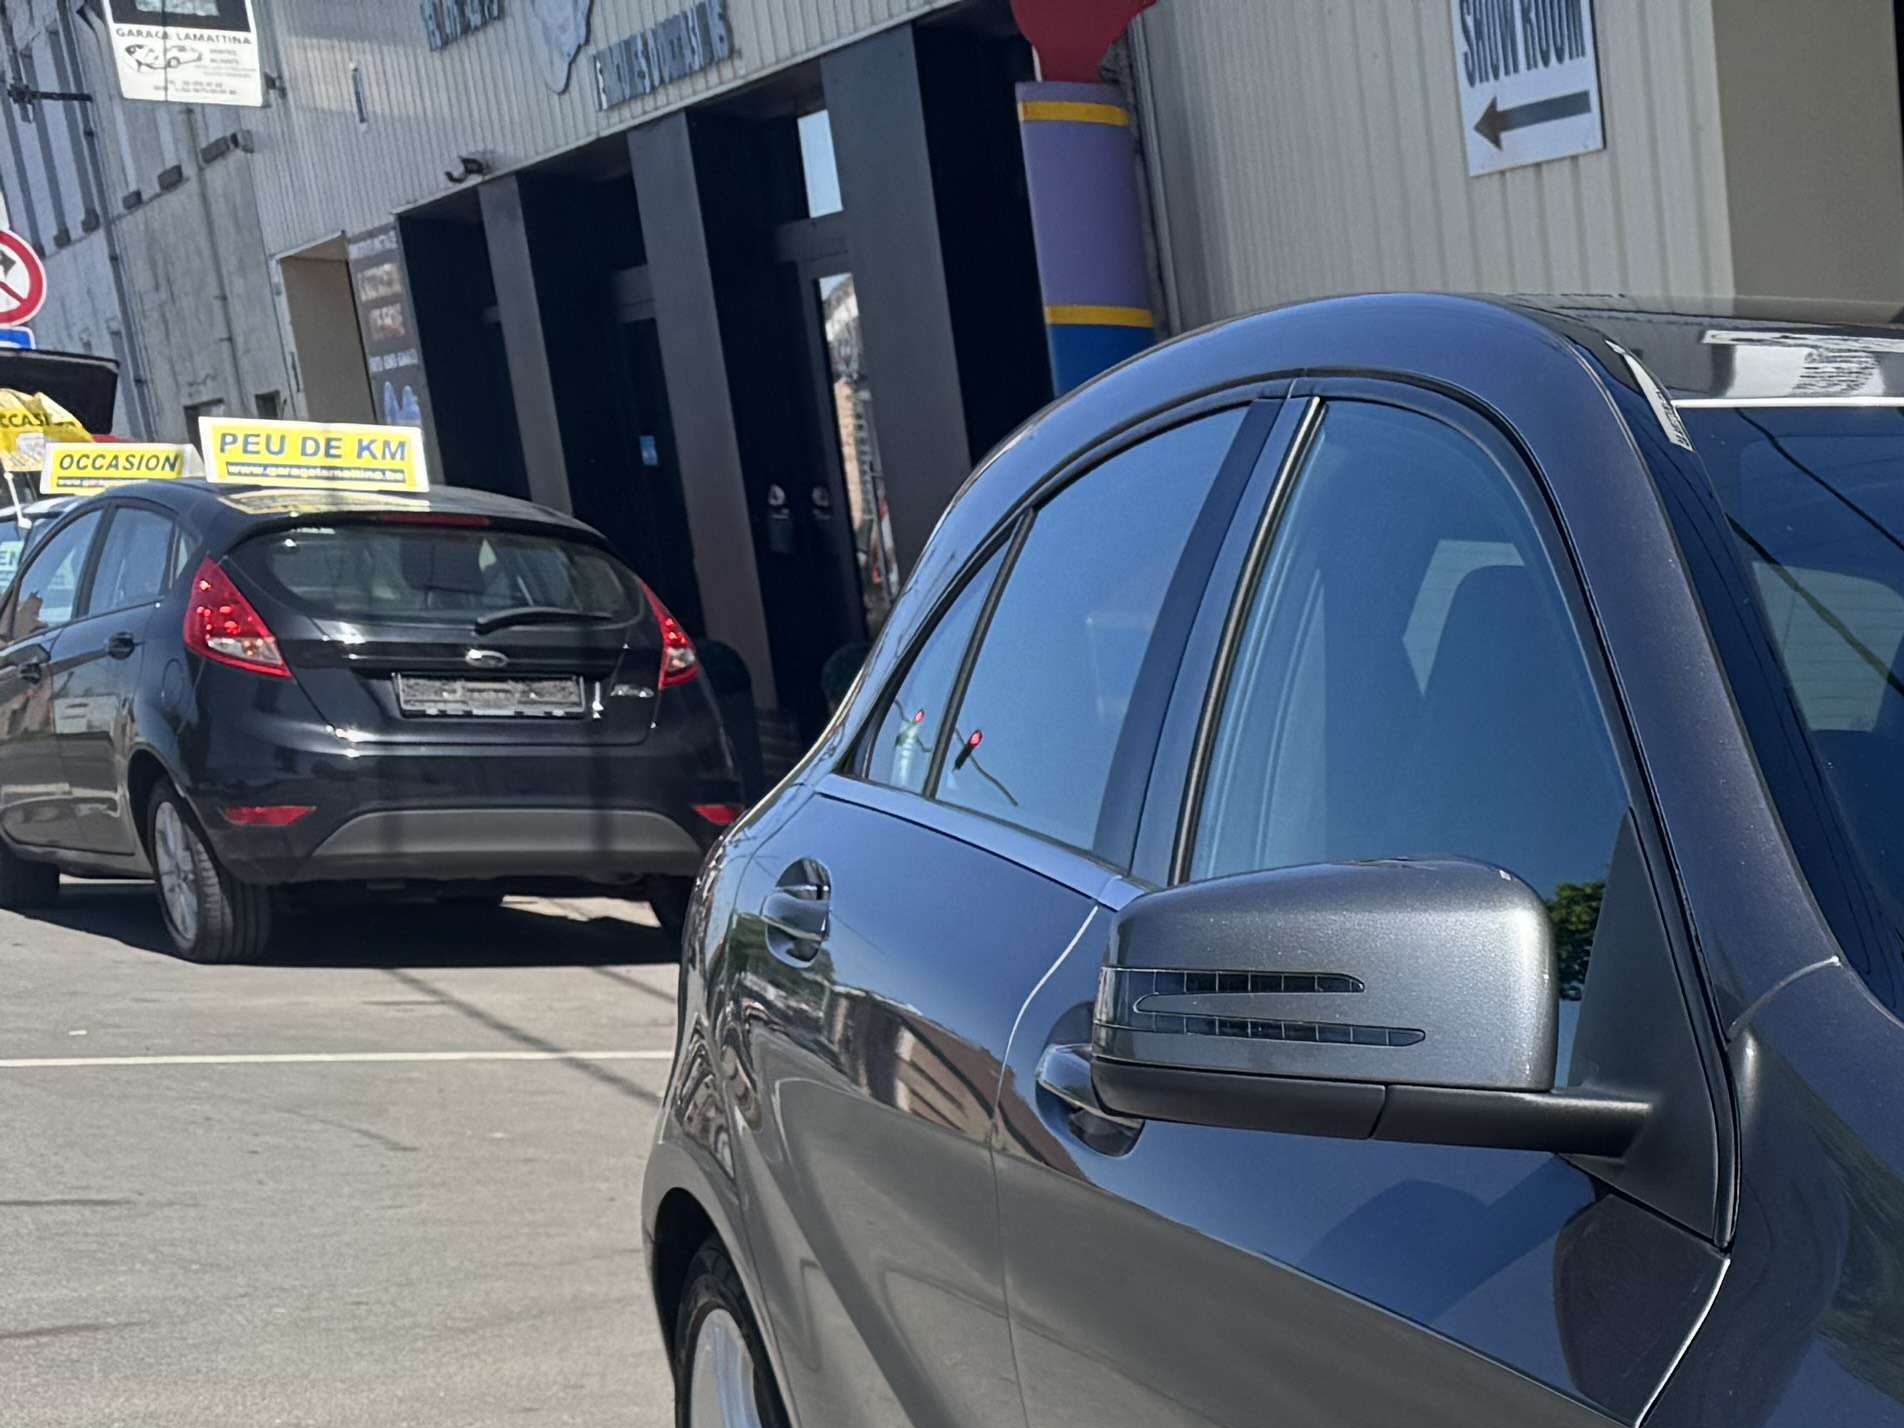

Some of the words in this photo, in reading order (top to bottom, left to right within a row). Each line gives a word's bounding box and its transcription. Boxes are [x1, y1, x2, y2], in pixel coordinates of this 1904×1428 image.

[1460, 0, 1520, 88] SHOW
[1521, 0, 1587, 71] ROOM
[219, 432, 287, 456] PEU
[300, 436, 343, 459] DE
[356, 438, 407, 462] KM
[58, 453, 179, 473] OCCASION
